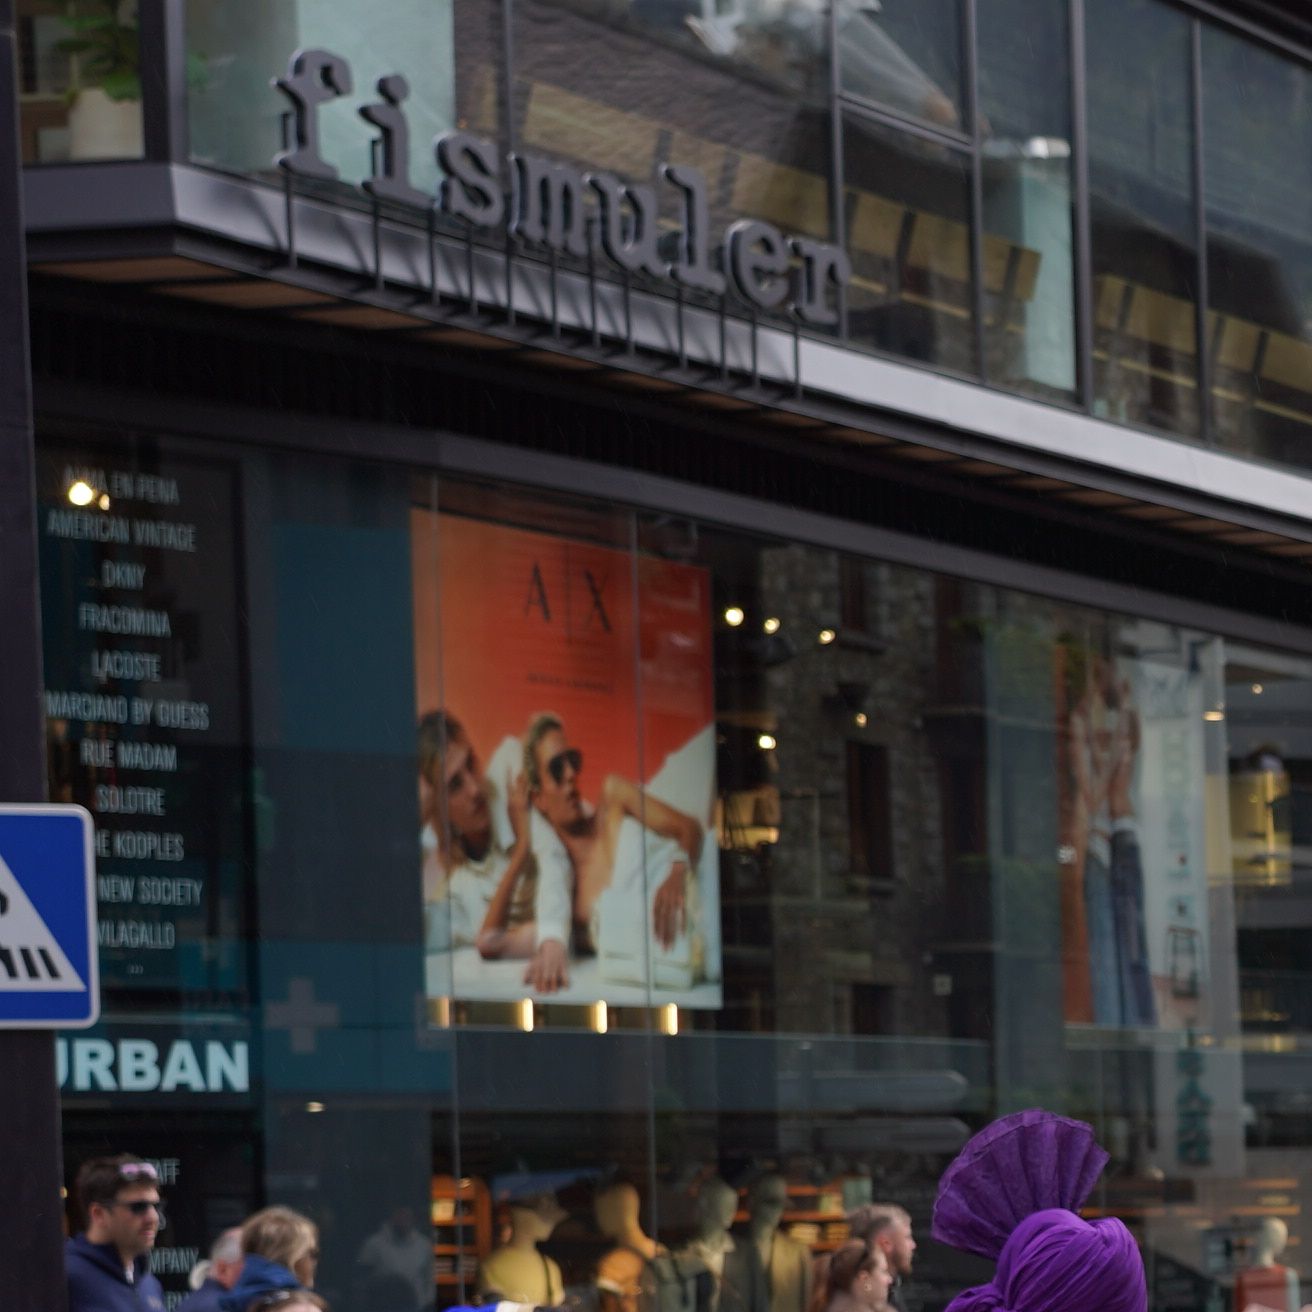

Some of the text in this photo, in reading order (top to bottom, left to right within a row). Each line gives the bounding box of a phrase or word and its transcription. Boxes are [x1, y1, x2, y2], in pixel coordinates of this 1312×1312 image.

[271, 48, 853, 326] fismuler
[48, 508, 197, 553] AMERICAN VINTAGE
[102, 559, 146, 590] DKNY
[78, 602, 172, 638] FRACOMINA
[91, 651, 161, 682] LACOSTE
[130, 697, 152, 726] BY
[81, 739, 178, 772] RUE MADAM
[113, 831, 185, 862] KOOPLES
[98, 873, 204, 906] NEW SOCIETY
[149, 1247, 199, 1275] MPANY
